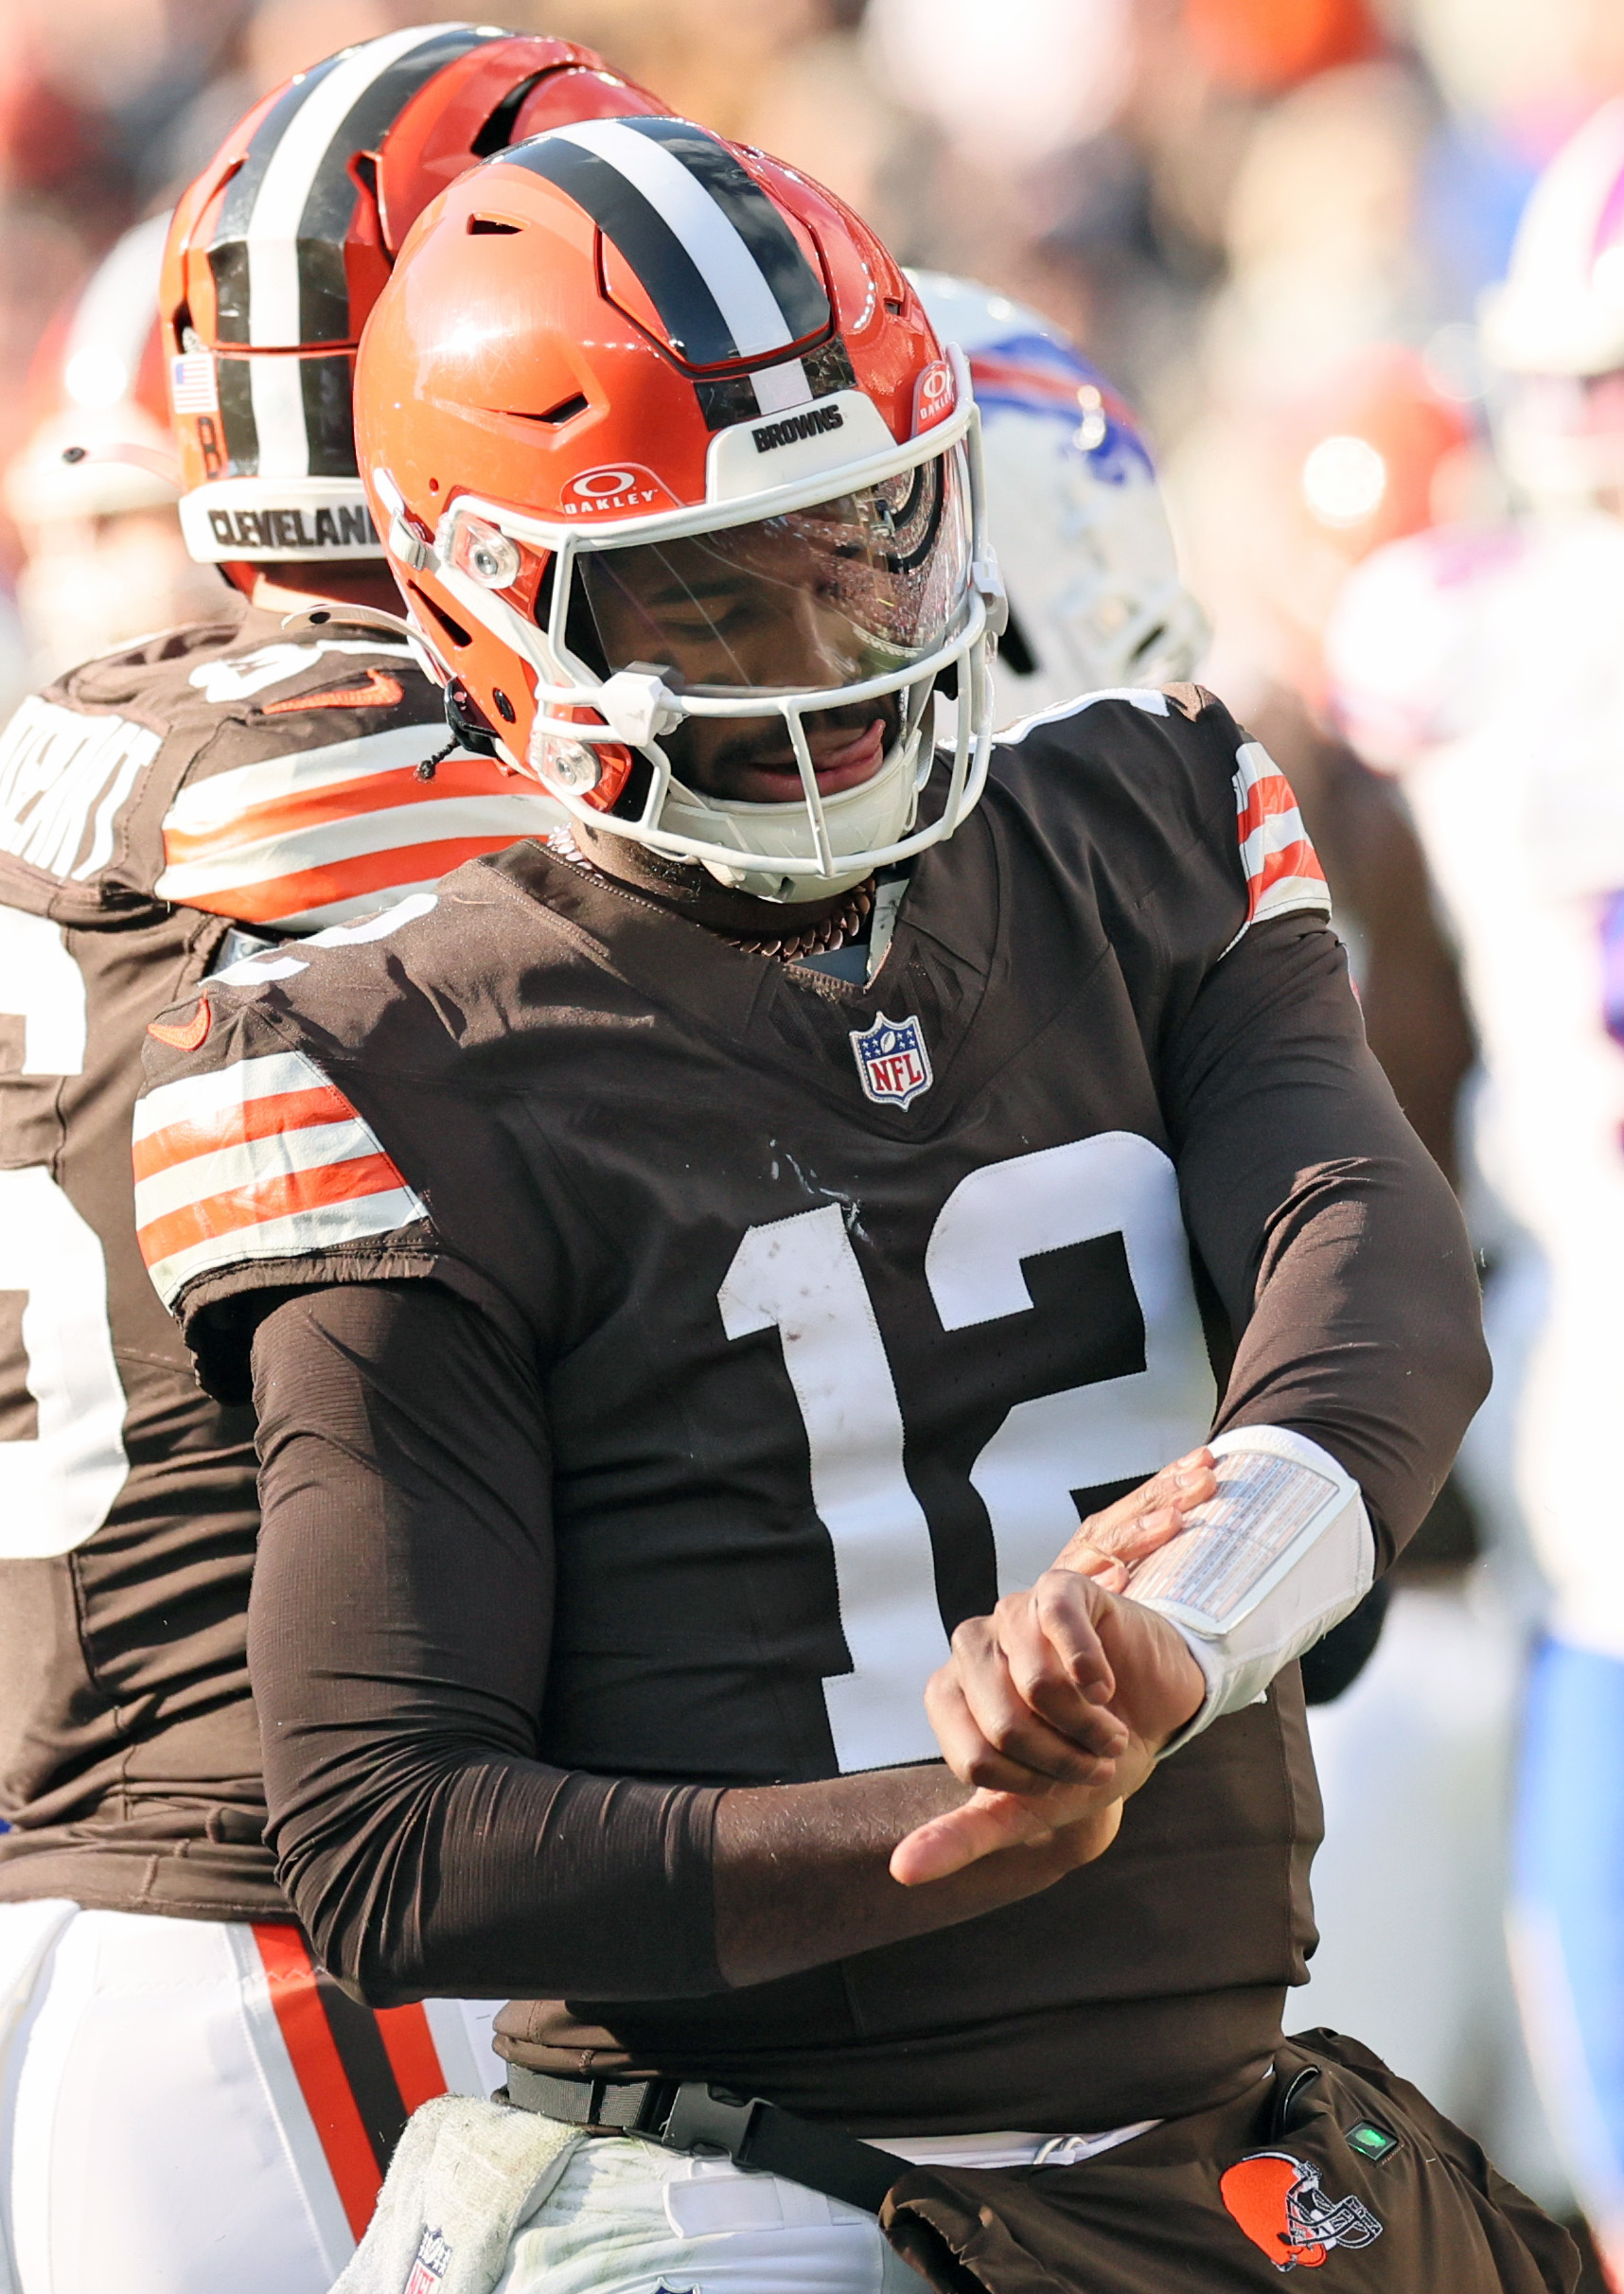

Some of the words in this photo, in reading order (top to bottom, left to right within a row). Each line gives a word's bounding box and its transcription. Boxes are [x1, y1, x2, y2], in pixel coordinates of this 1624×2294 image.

[751, 404, 843, 453] BROWNS
[565, 490, 655, 515] OAKLEY
[870, 1053, 922, 1092] NFL
[716, 1130, 1219, 1774] 12
